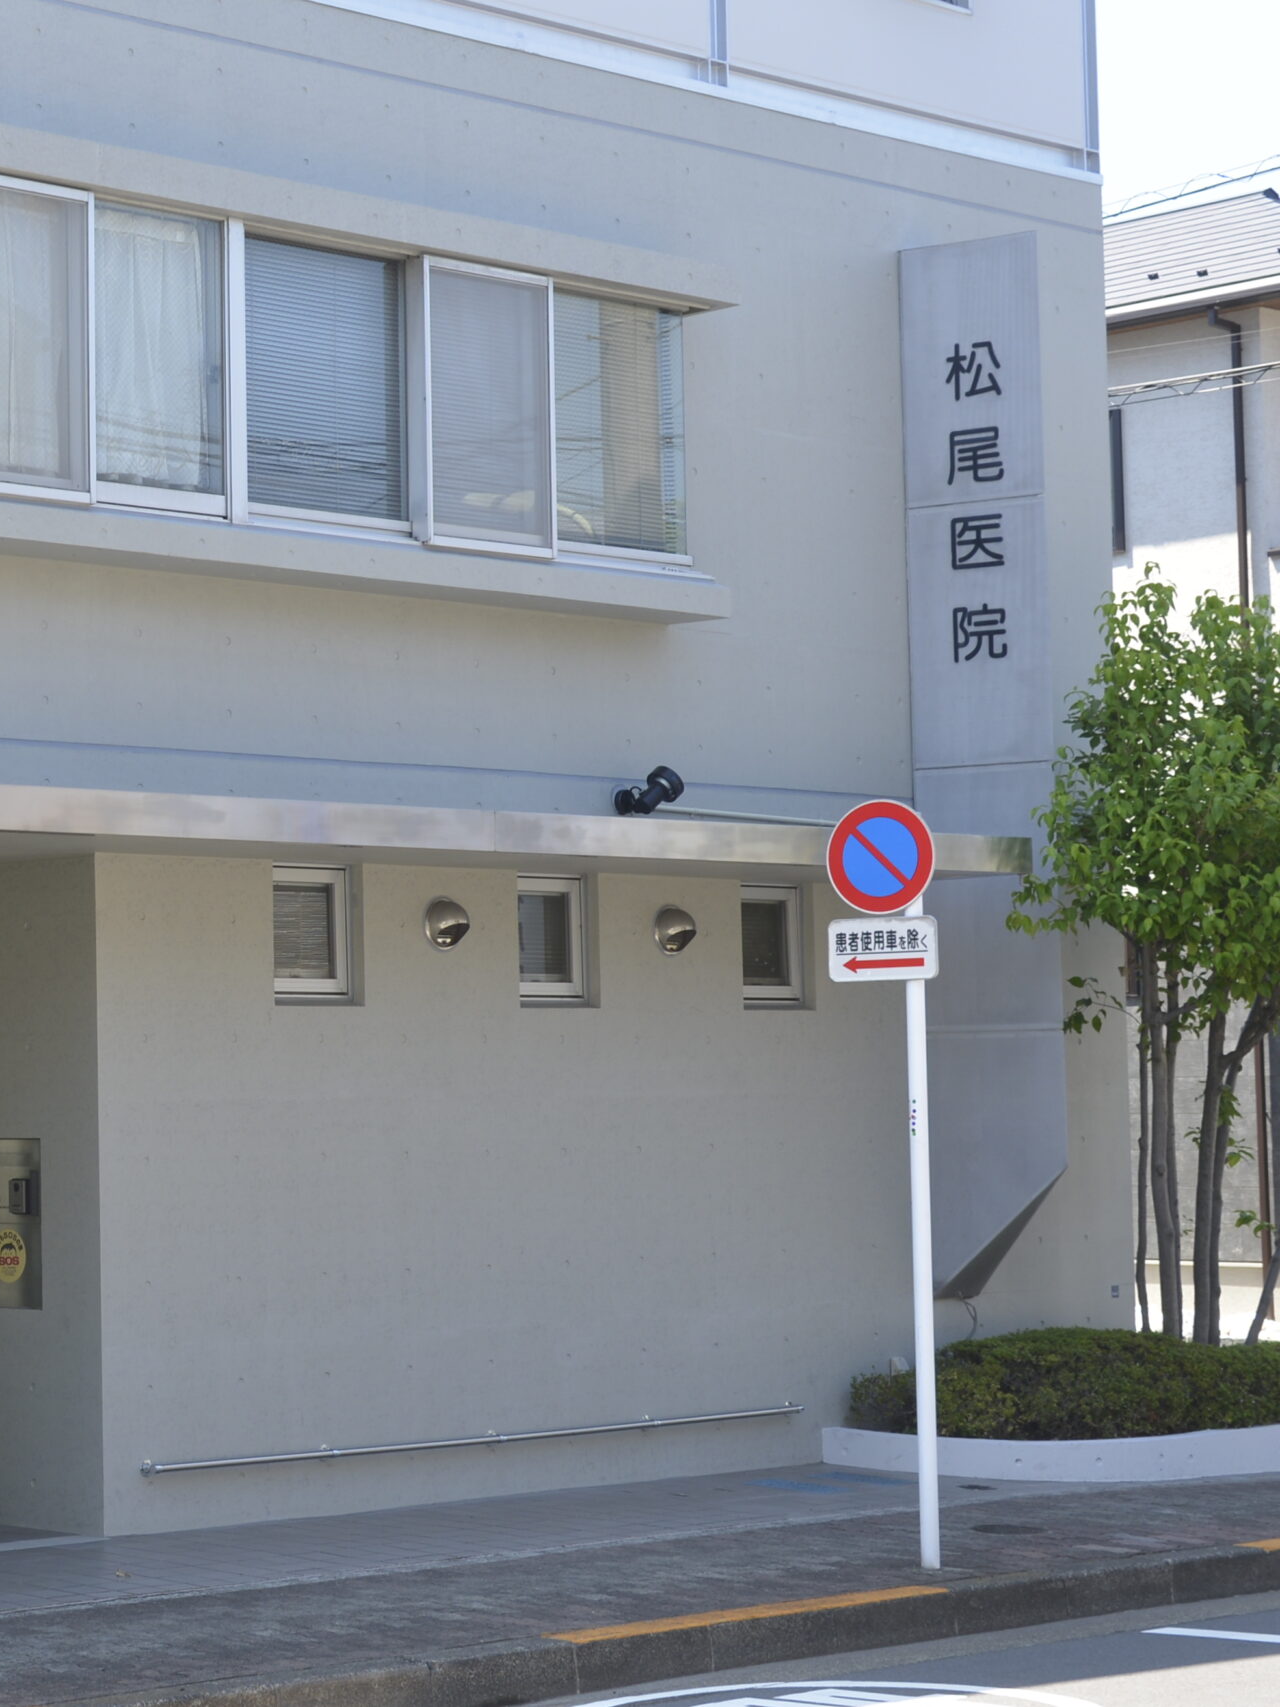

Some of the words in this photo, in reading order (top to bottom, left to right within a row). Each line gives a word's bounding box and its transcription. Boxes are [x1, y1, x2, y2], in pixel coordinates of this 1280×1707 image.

[945, 340, 1008, 663] 松尾医院
[835, 929, 928, 953] 患者使用車を除く
[0, 1256, 20, 1265] SOS
